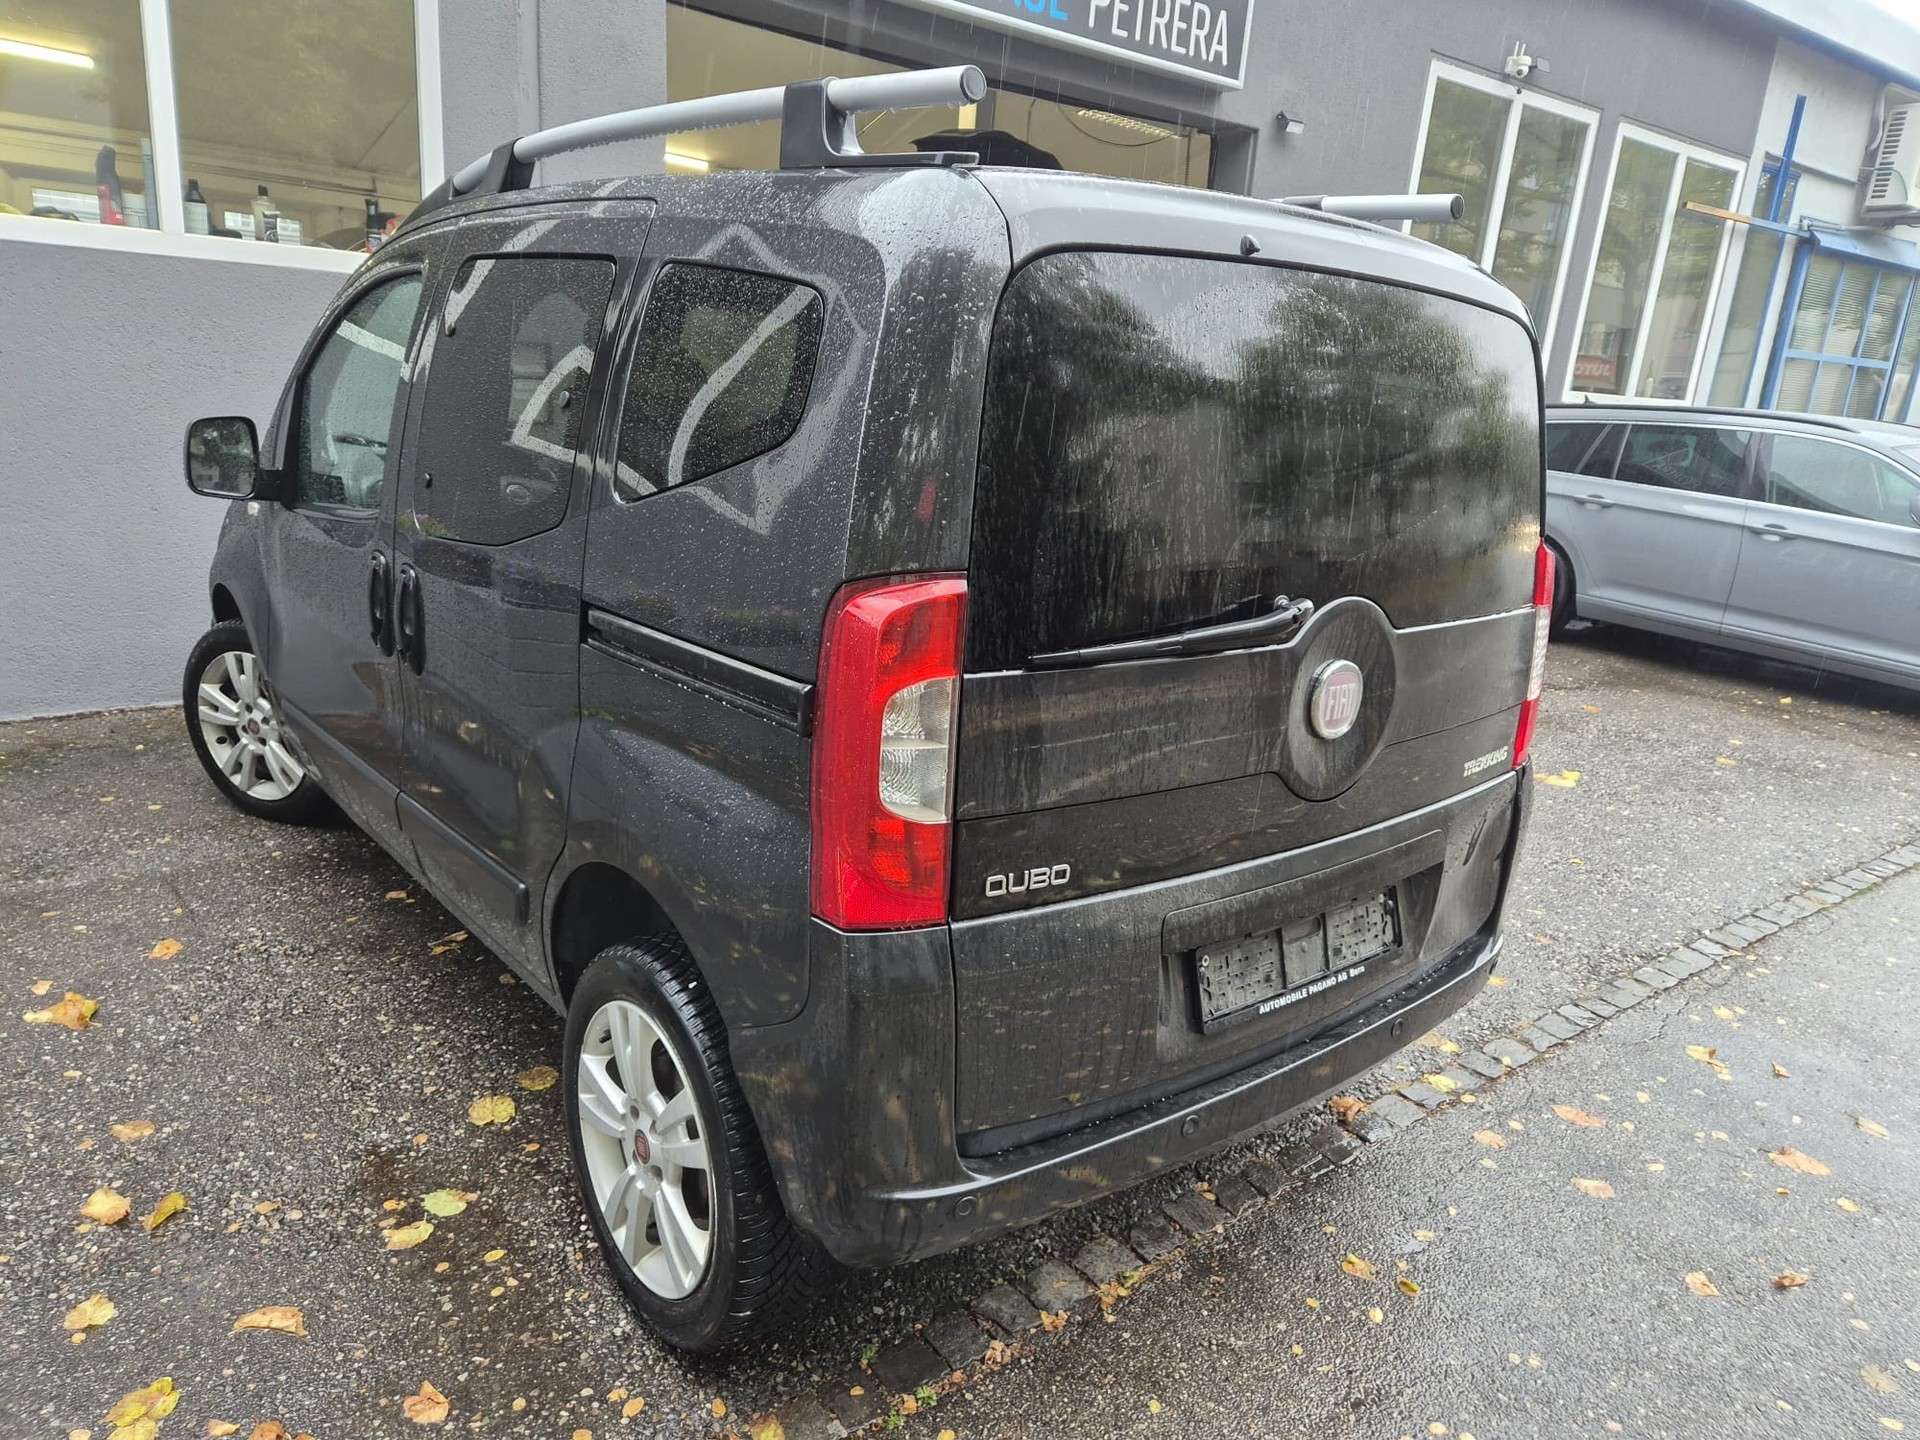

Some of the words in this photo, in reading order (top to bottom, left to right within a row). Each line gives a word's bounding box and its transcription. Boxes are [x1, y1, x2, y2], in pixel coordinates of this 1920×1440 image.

[1574, 362, 1610, 377] OTUL
[1325, 683, 1355, 720] FIAT
[1463, 746, 1508, 777] TREKKING
[985, 863, 1071, 898] QUBO
[1259, 988, 1307, 1014] AUTOMOBILE
[1308, 976, 1337, 996] PAGANO
[1337, 971, 1348, 983] AG
